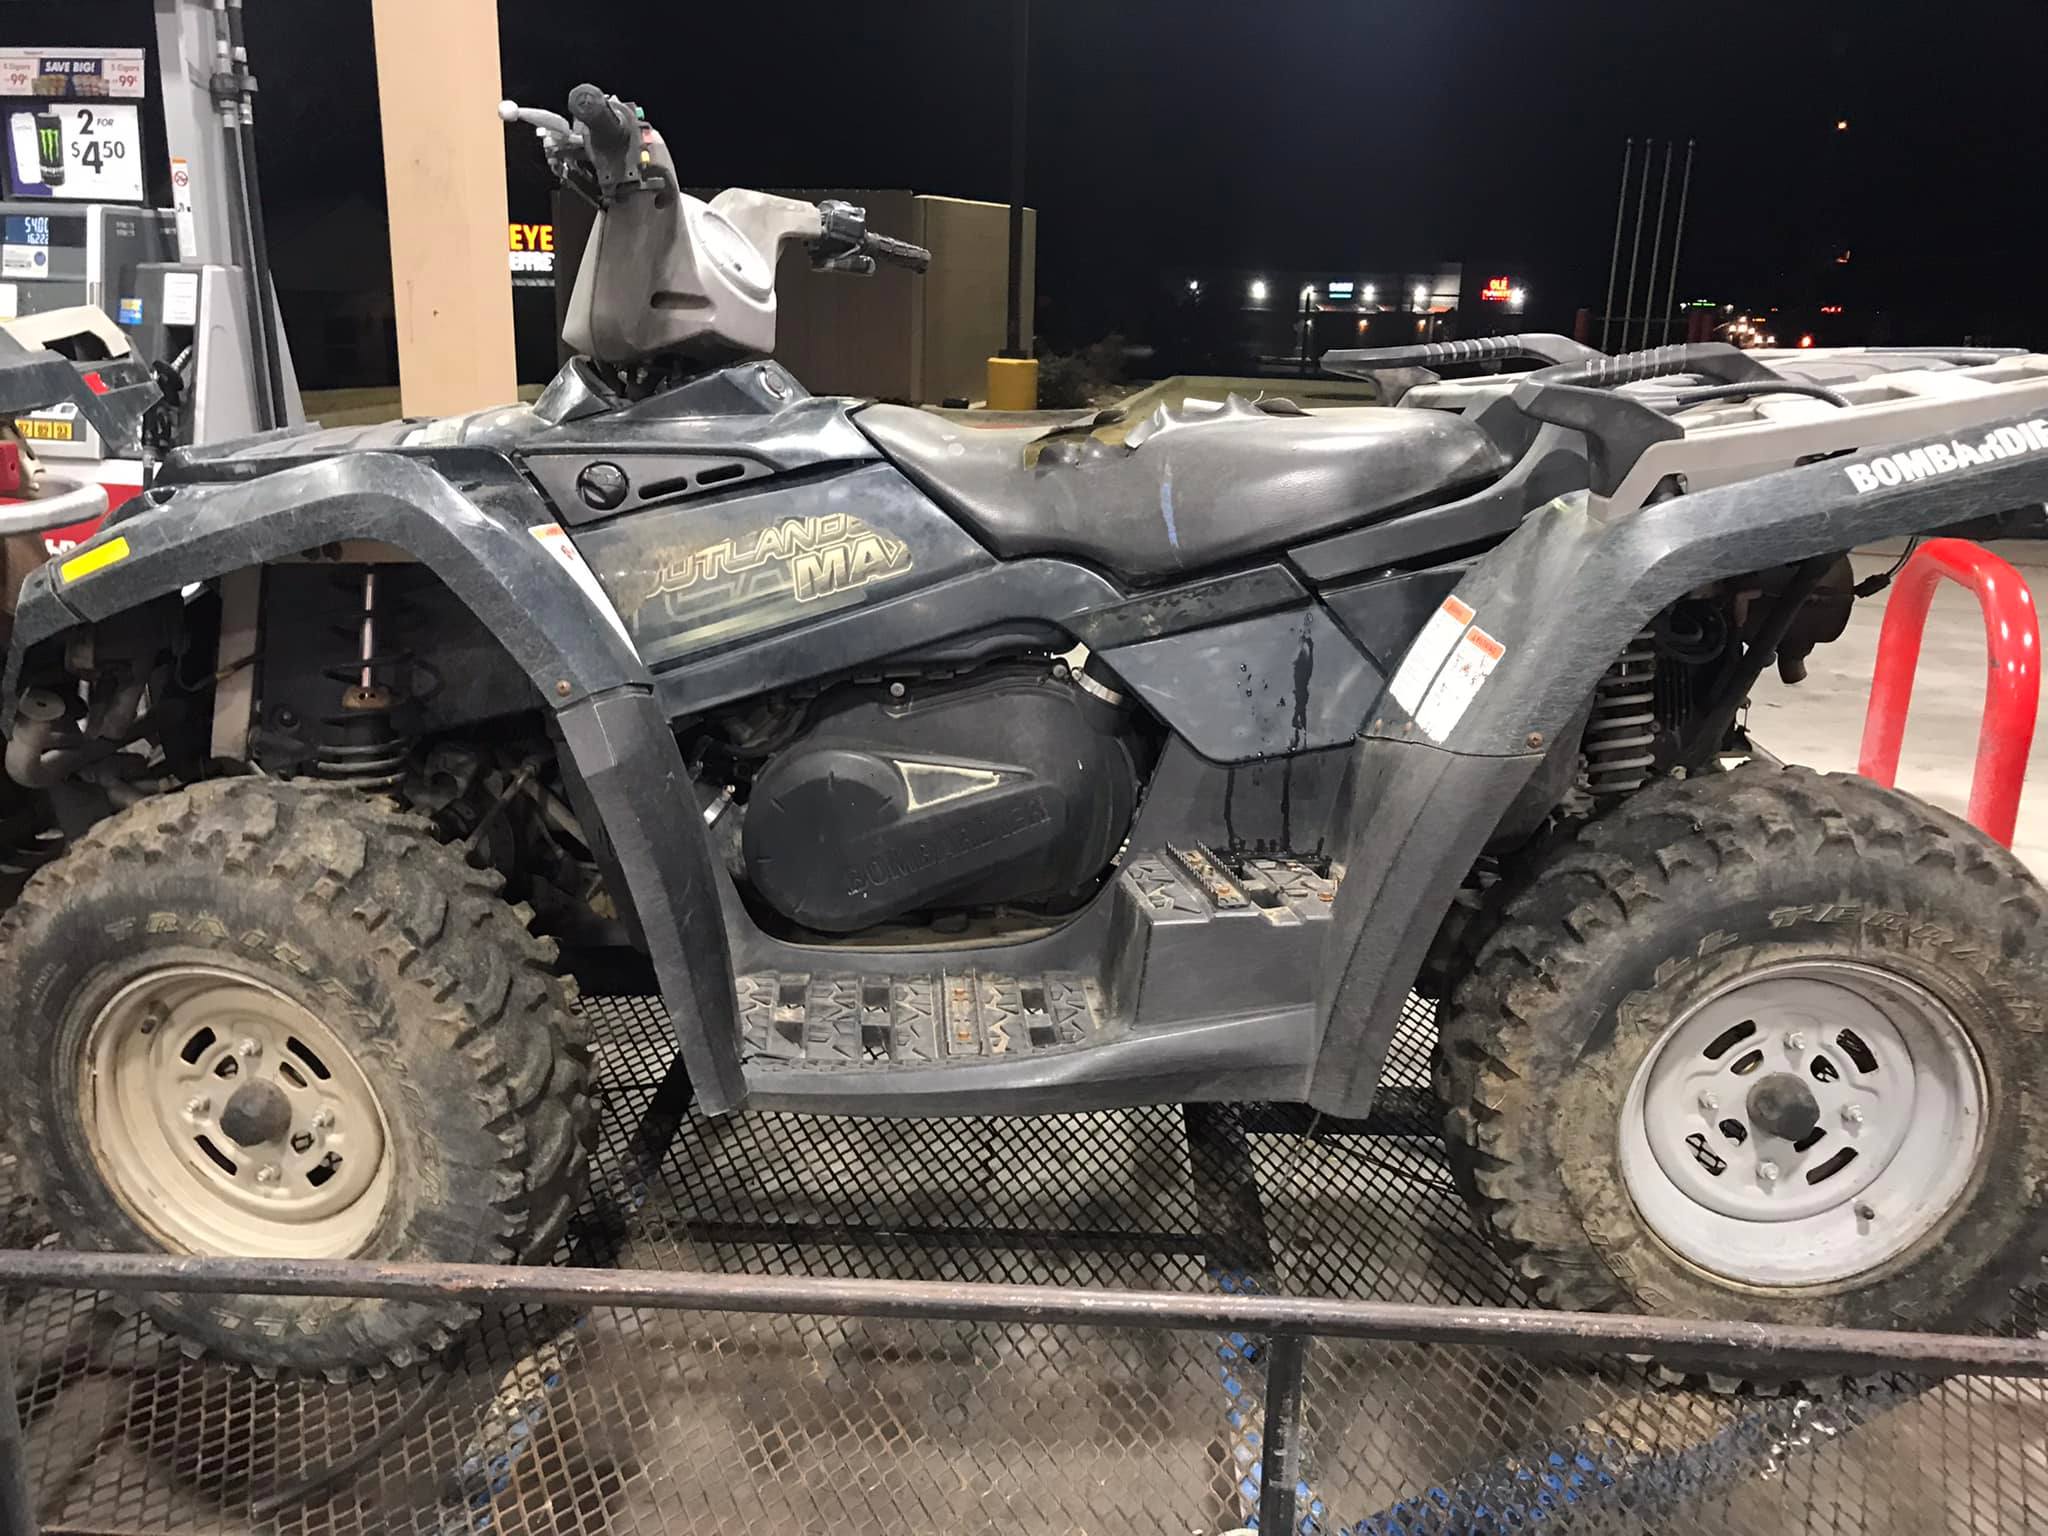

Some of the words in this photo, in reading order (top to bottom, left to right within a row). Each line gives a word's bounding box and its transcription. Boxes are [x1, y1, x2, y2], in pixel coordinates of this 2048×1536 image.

[45, 61, 70, 72] SAVE
[73, 62, 95, 73] BIG!
[77, 109, 94, 135] 2
[97, 118, 114, 126] FOR
[509, 223, 554, 251] EYE
